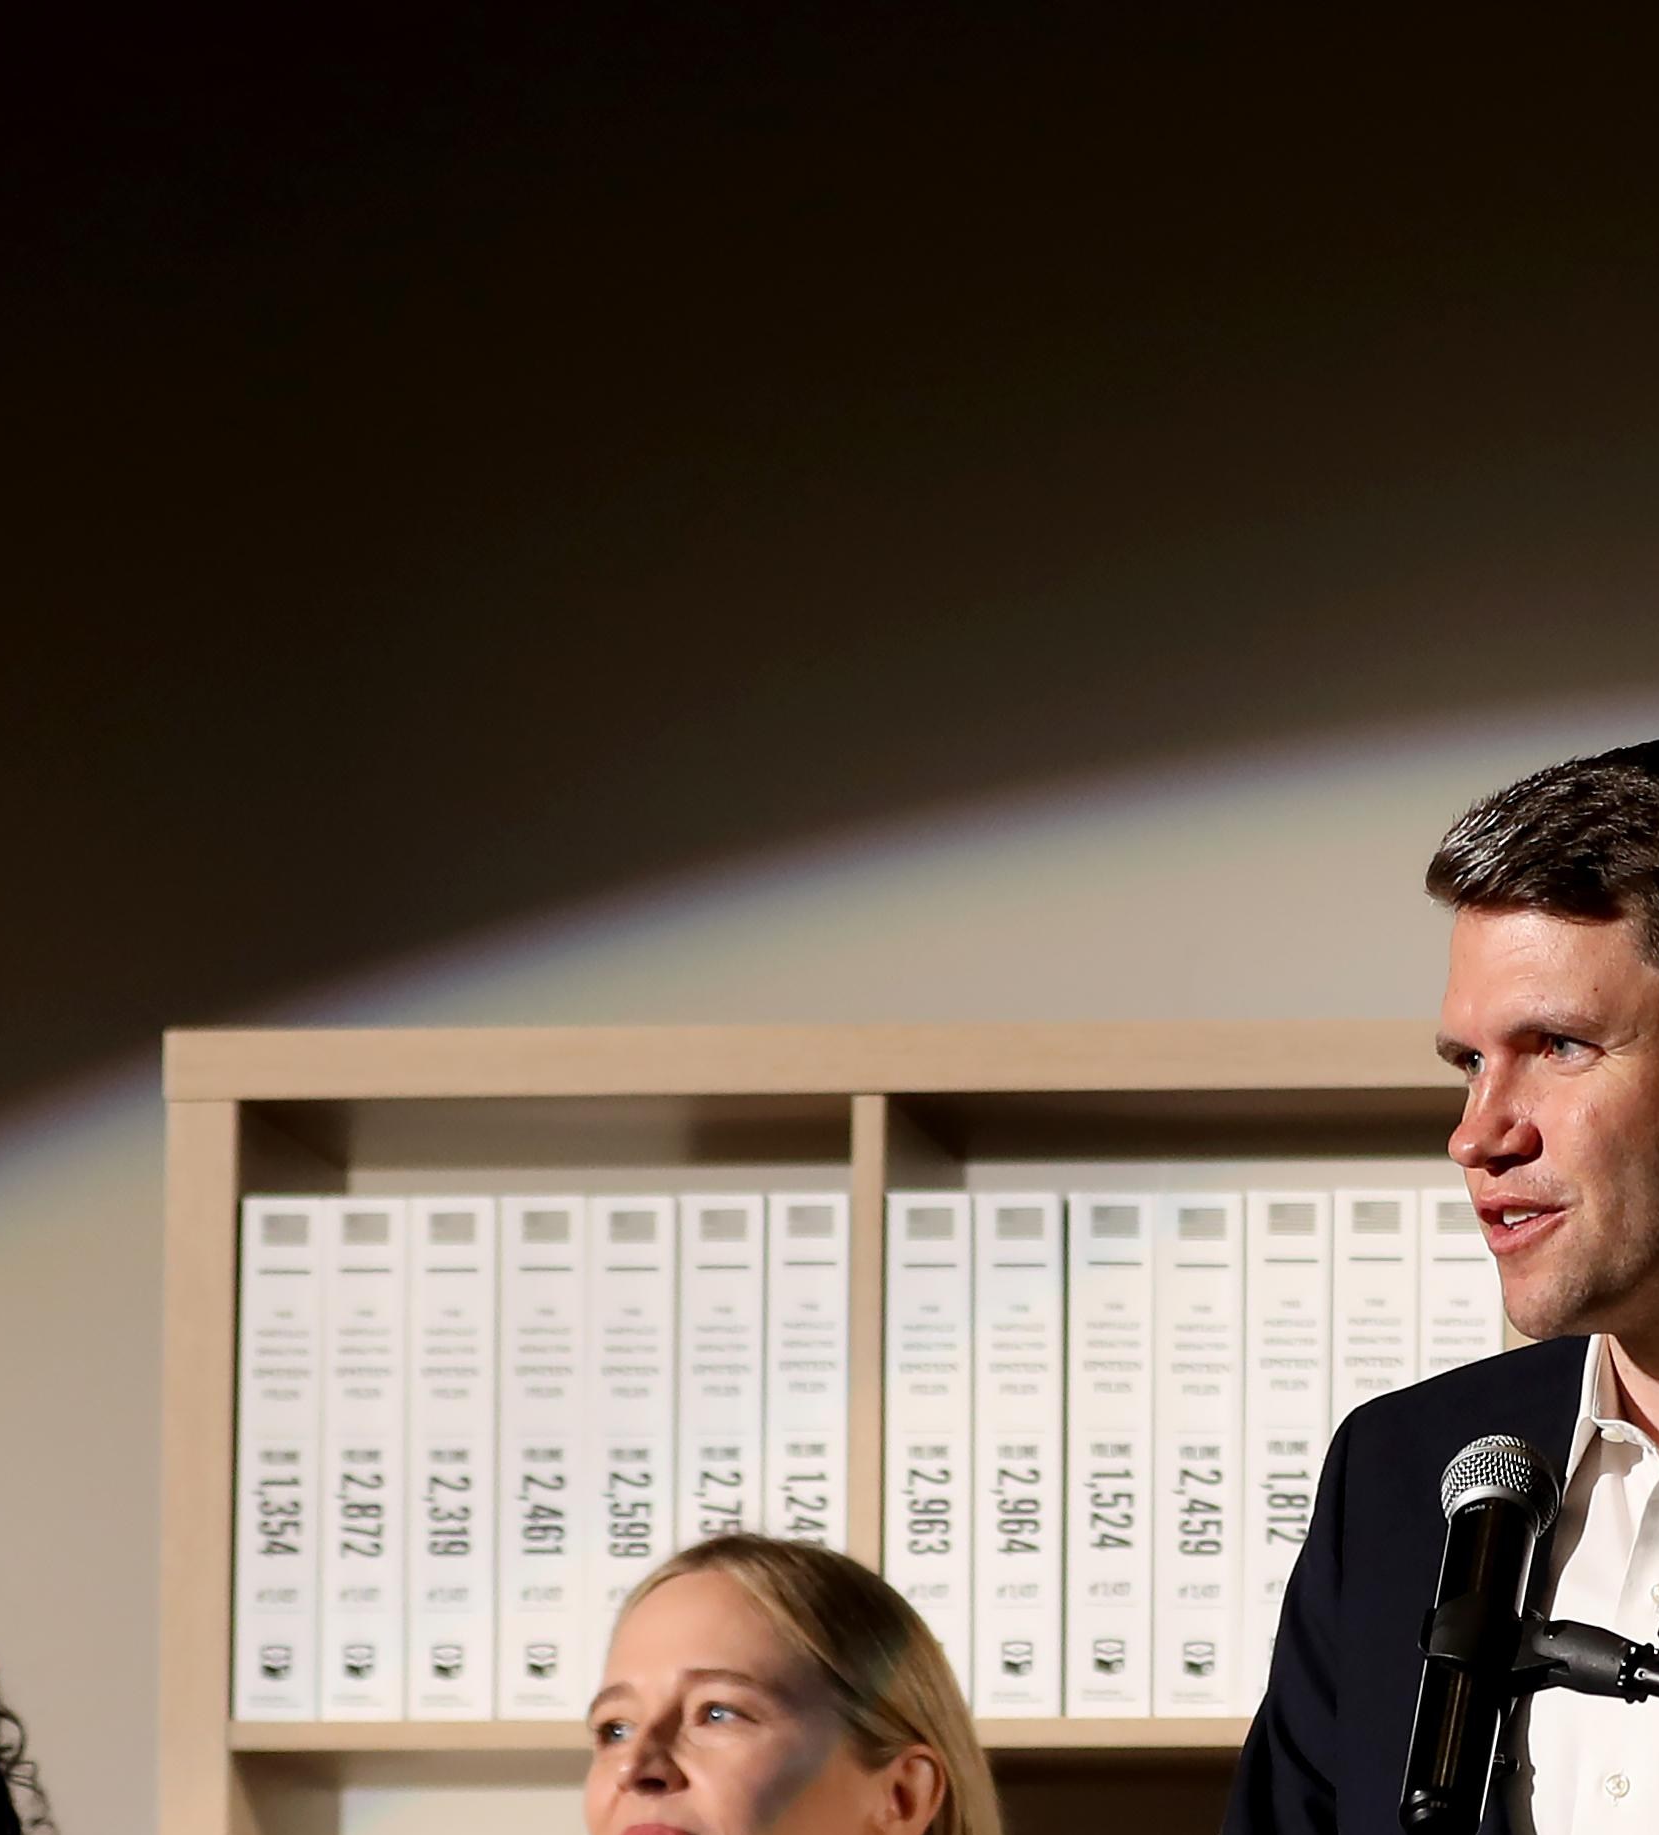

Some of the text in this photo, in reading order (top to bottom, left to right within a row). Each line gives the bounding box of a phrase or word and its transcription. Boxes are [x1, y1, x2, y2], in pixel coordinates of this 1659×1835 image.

[255, 1477, 302, 1556] 1,354
[337, 1473, 384, 1557] 2,872
[424, 1475, 472, 1556] 2,319
[518, 1474, 566, 1554] 2,461
[603, 1471, 653, 1558] 2,599
[694, 1470, 743, 1535] 2,75
[781, 1471, 828, 1544] 1,24
[903, 1469, 952, 1555] 2,963
[992, 1468, 1041, 1554] 2,964
[1085, 1469, 1135, 1550] 1,524
[1173, 1468, 1223, 1556] 2,459
[1260, 1469, 1310, 1545] 1,812
